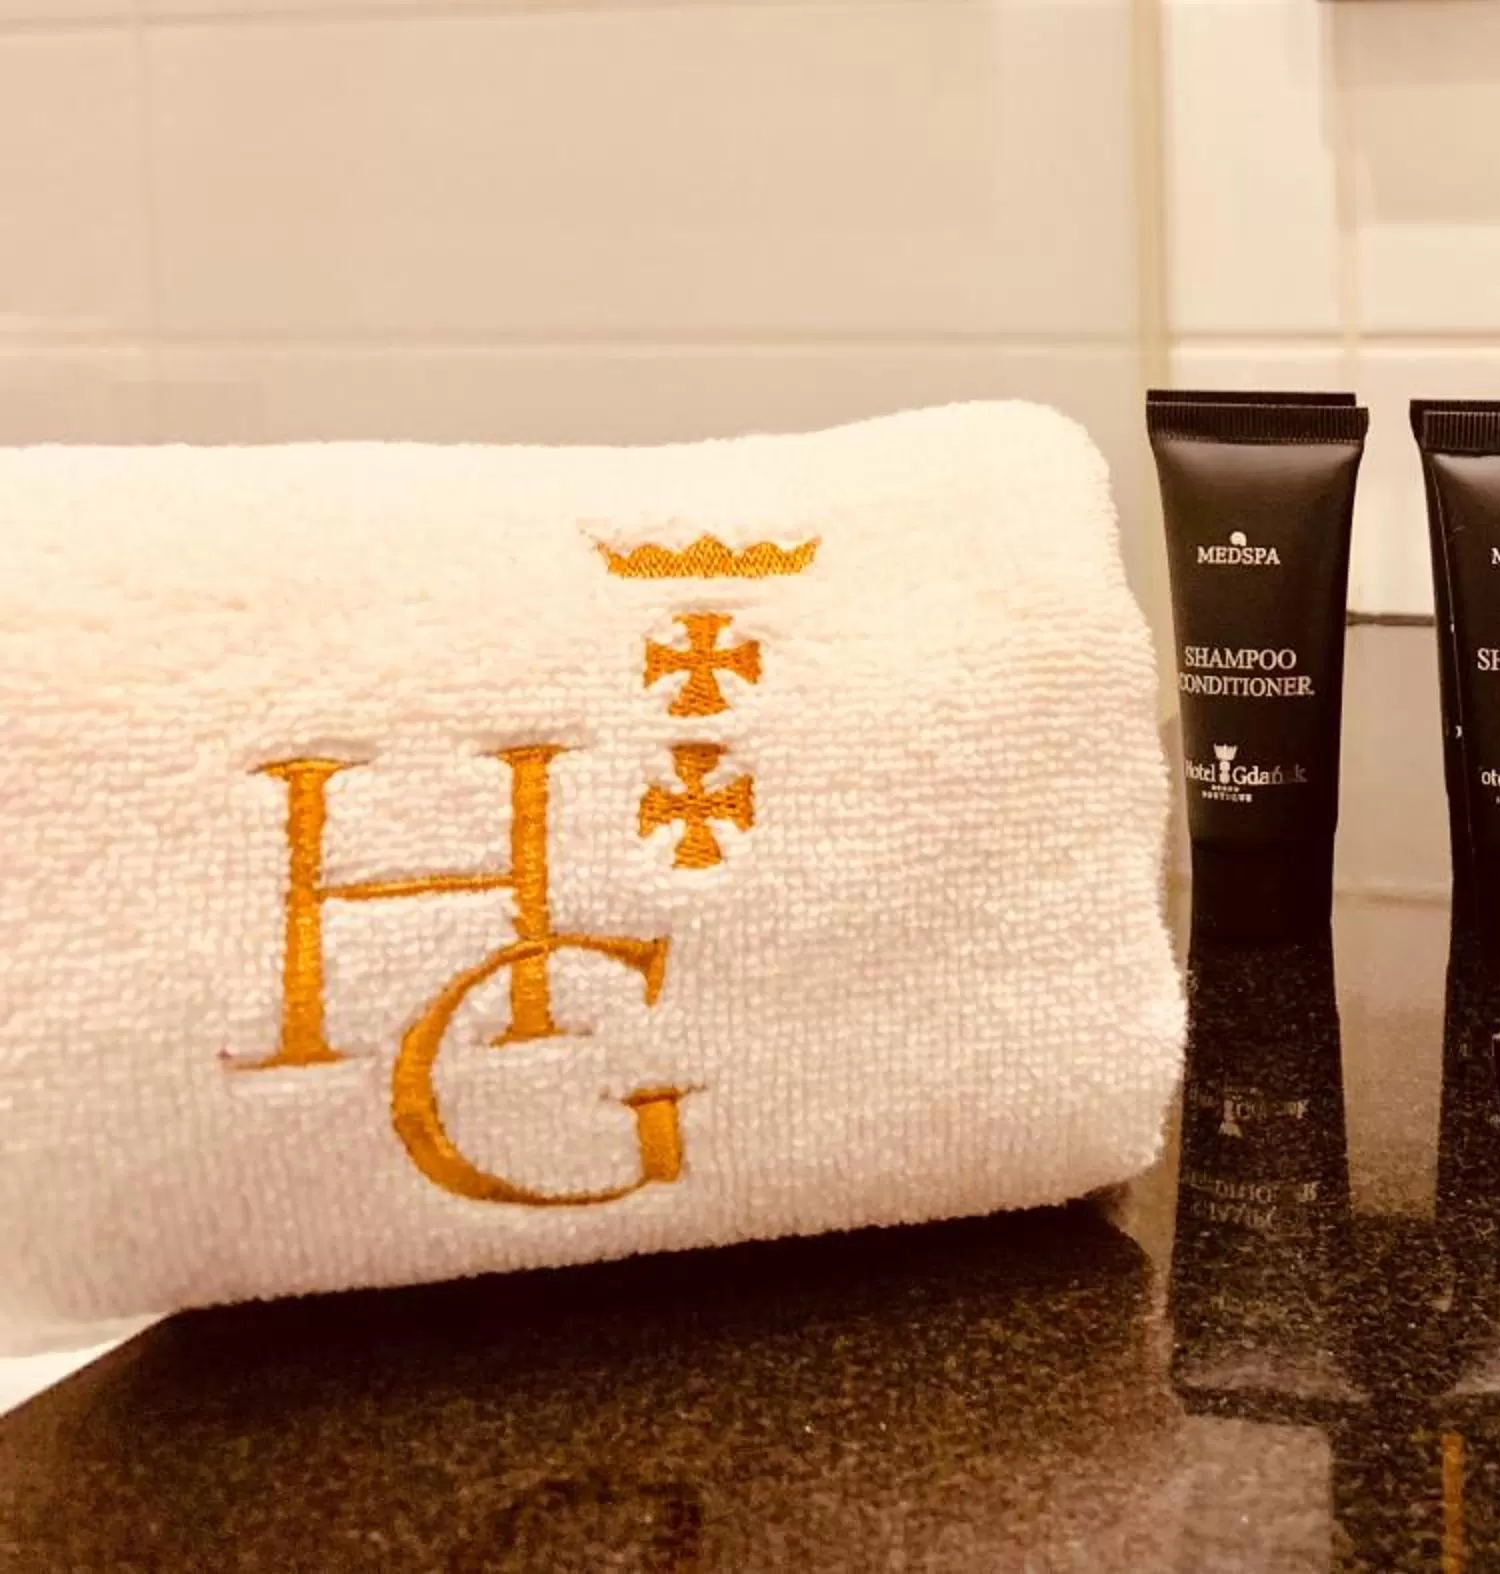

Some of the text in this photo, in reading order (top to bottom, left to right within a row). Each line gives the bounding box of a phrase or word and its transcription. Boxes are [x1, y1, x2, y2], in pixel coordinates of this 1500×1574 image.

[1197, 546, 1281, 565] MEDSPA
[1185, 646, 1297, 670] SHAMPOO
[1179, 672, 1315, 697] CONDITIONER
[1232, 765, 1308, 785] Gdańk
